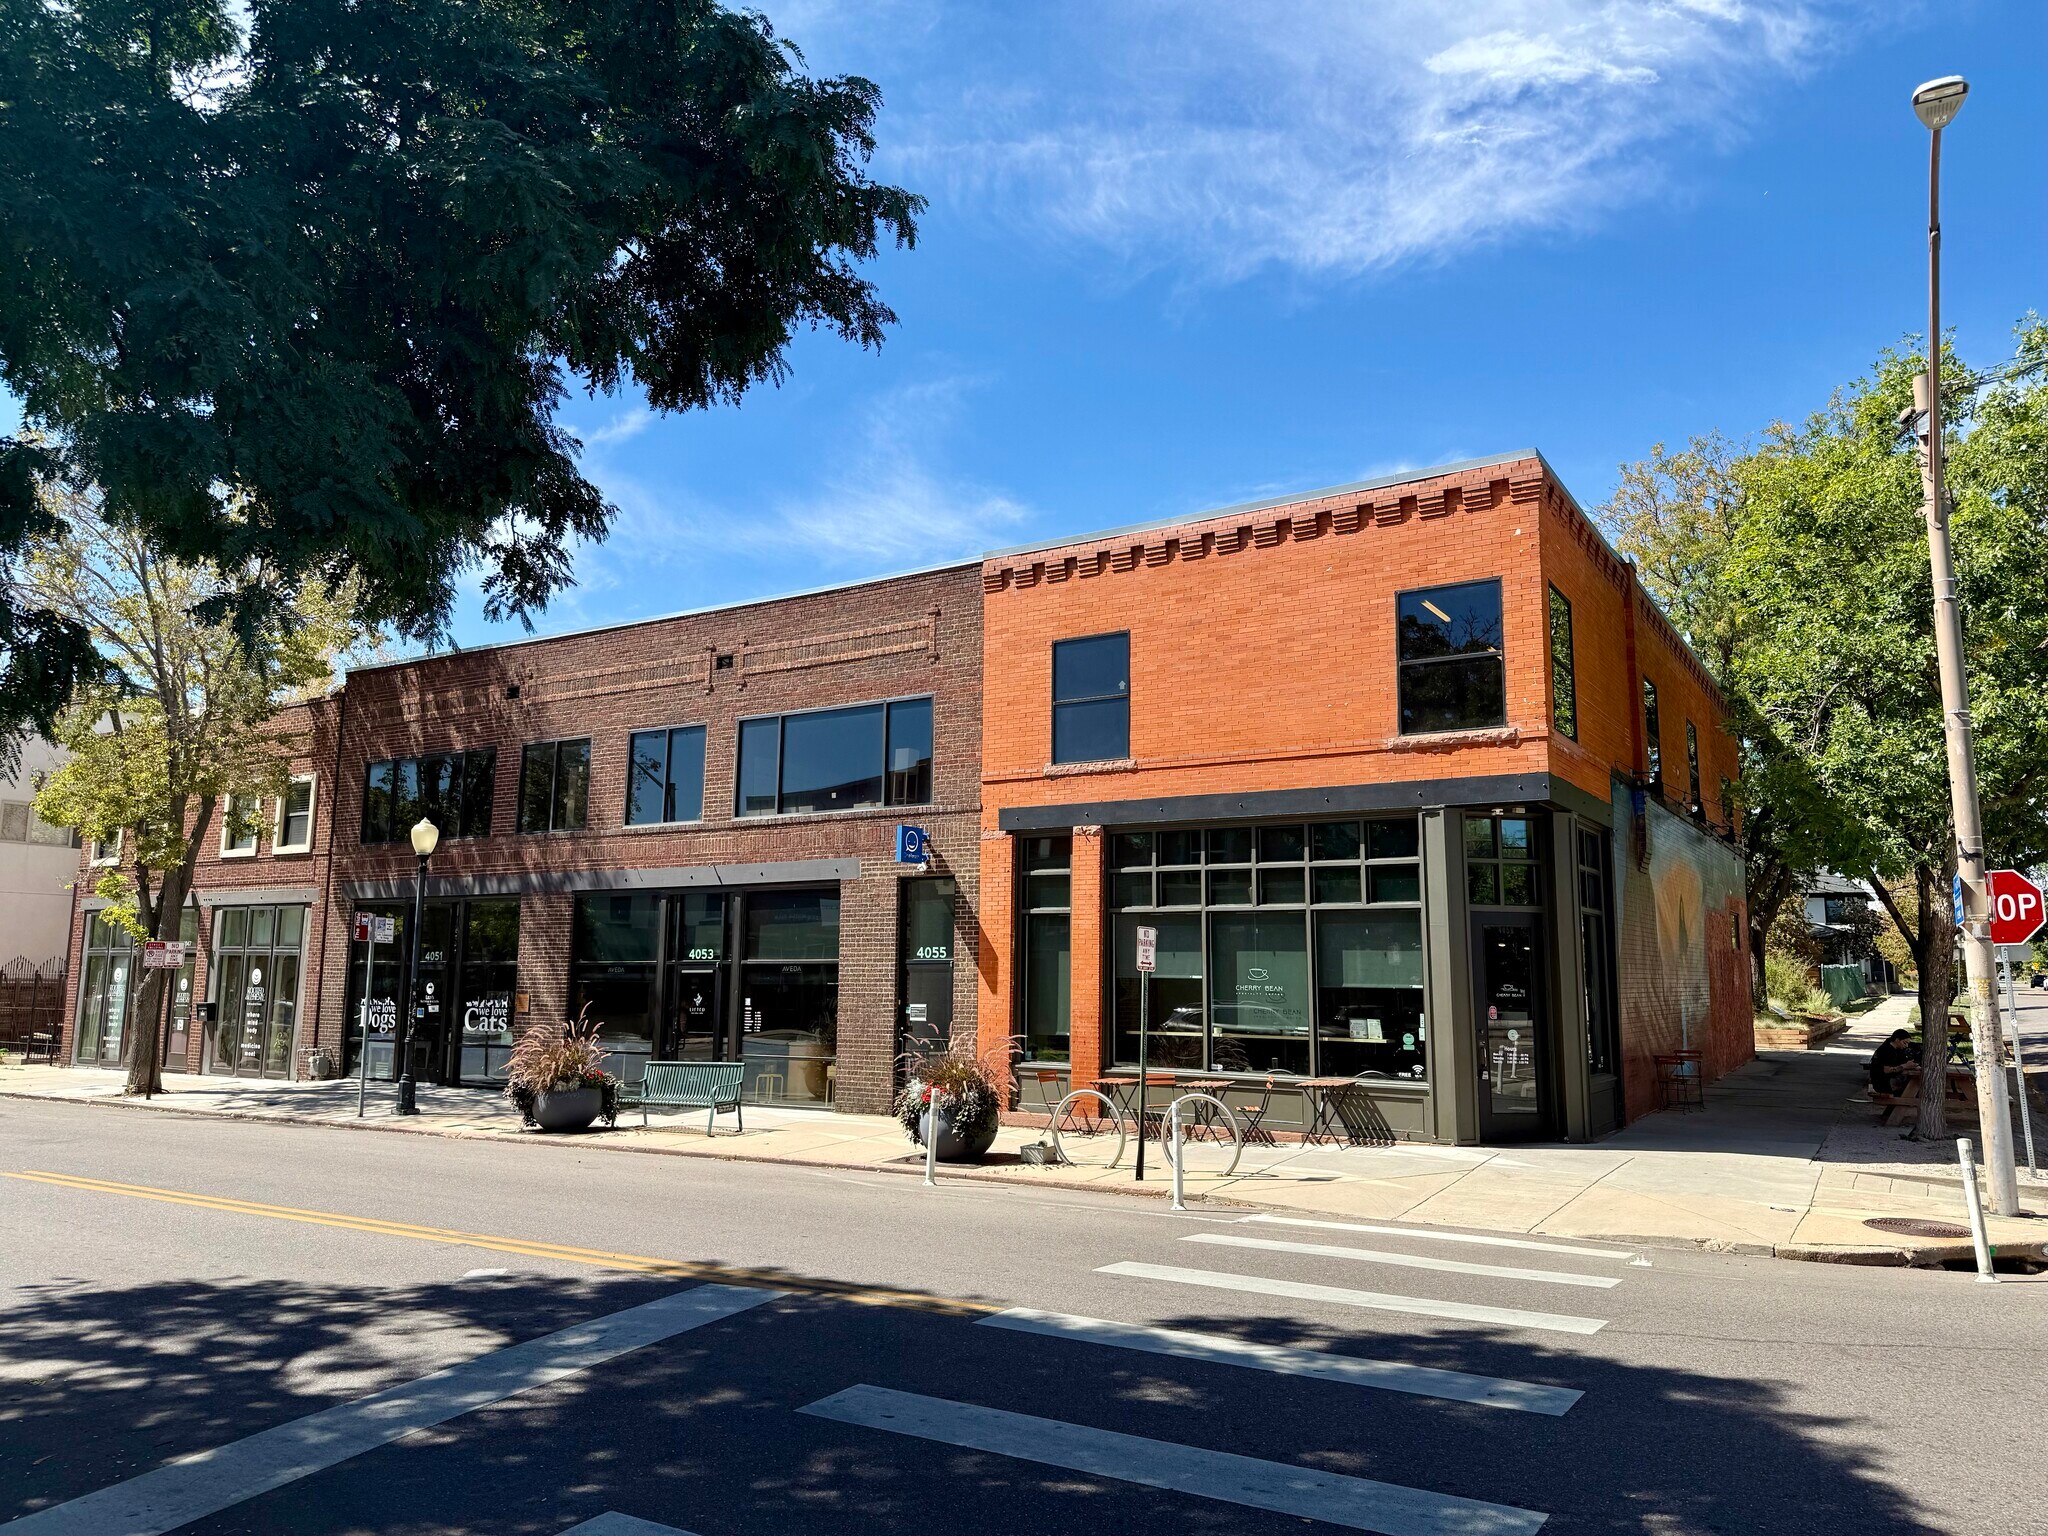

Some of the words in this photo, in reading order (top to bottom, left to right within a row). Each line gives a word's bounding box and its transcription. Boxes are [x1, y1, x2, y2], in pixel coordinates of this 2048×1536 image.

[1139, 939, 1154, 948] PARKING
[425, 952, 443, 961] 4051
[688, 949, 714, 960] 4053
[916, 947, 947, 958] 4055
[382, 1003, 396, 1013] love
[492, 1005, 507, 1016] love
[359, 1006, 396, 1034] Dogs
[464, 1008, 507, 1032] Cats
